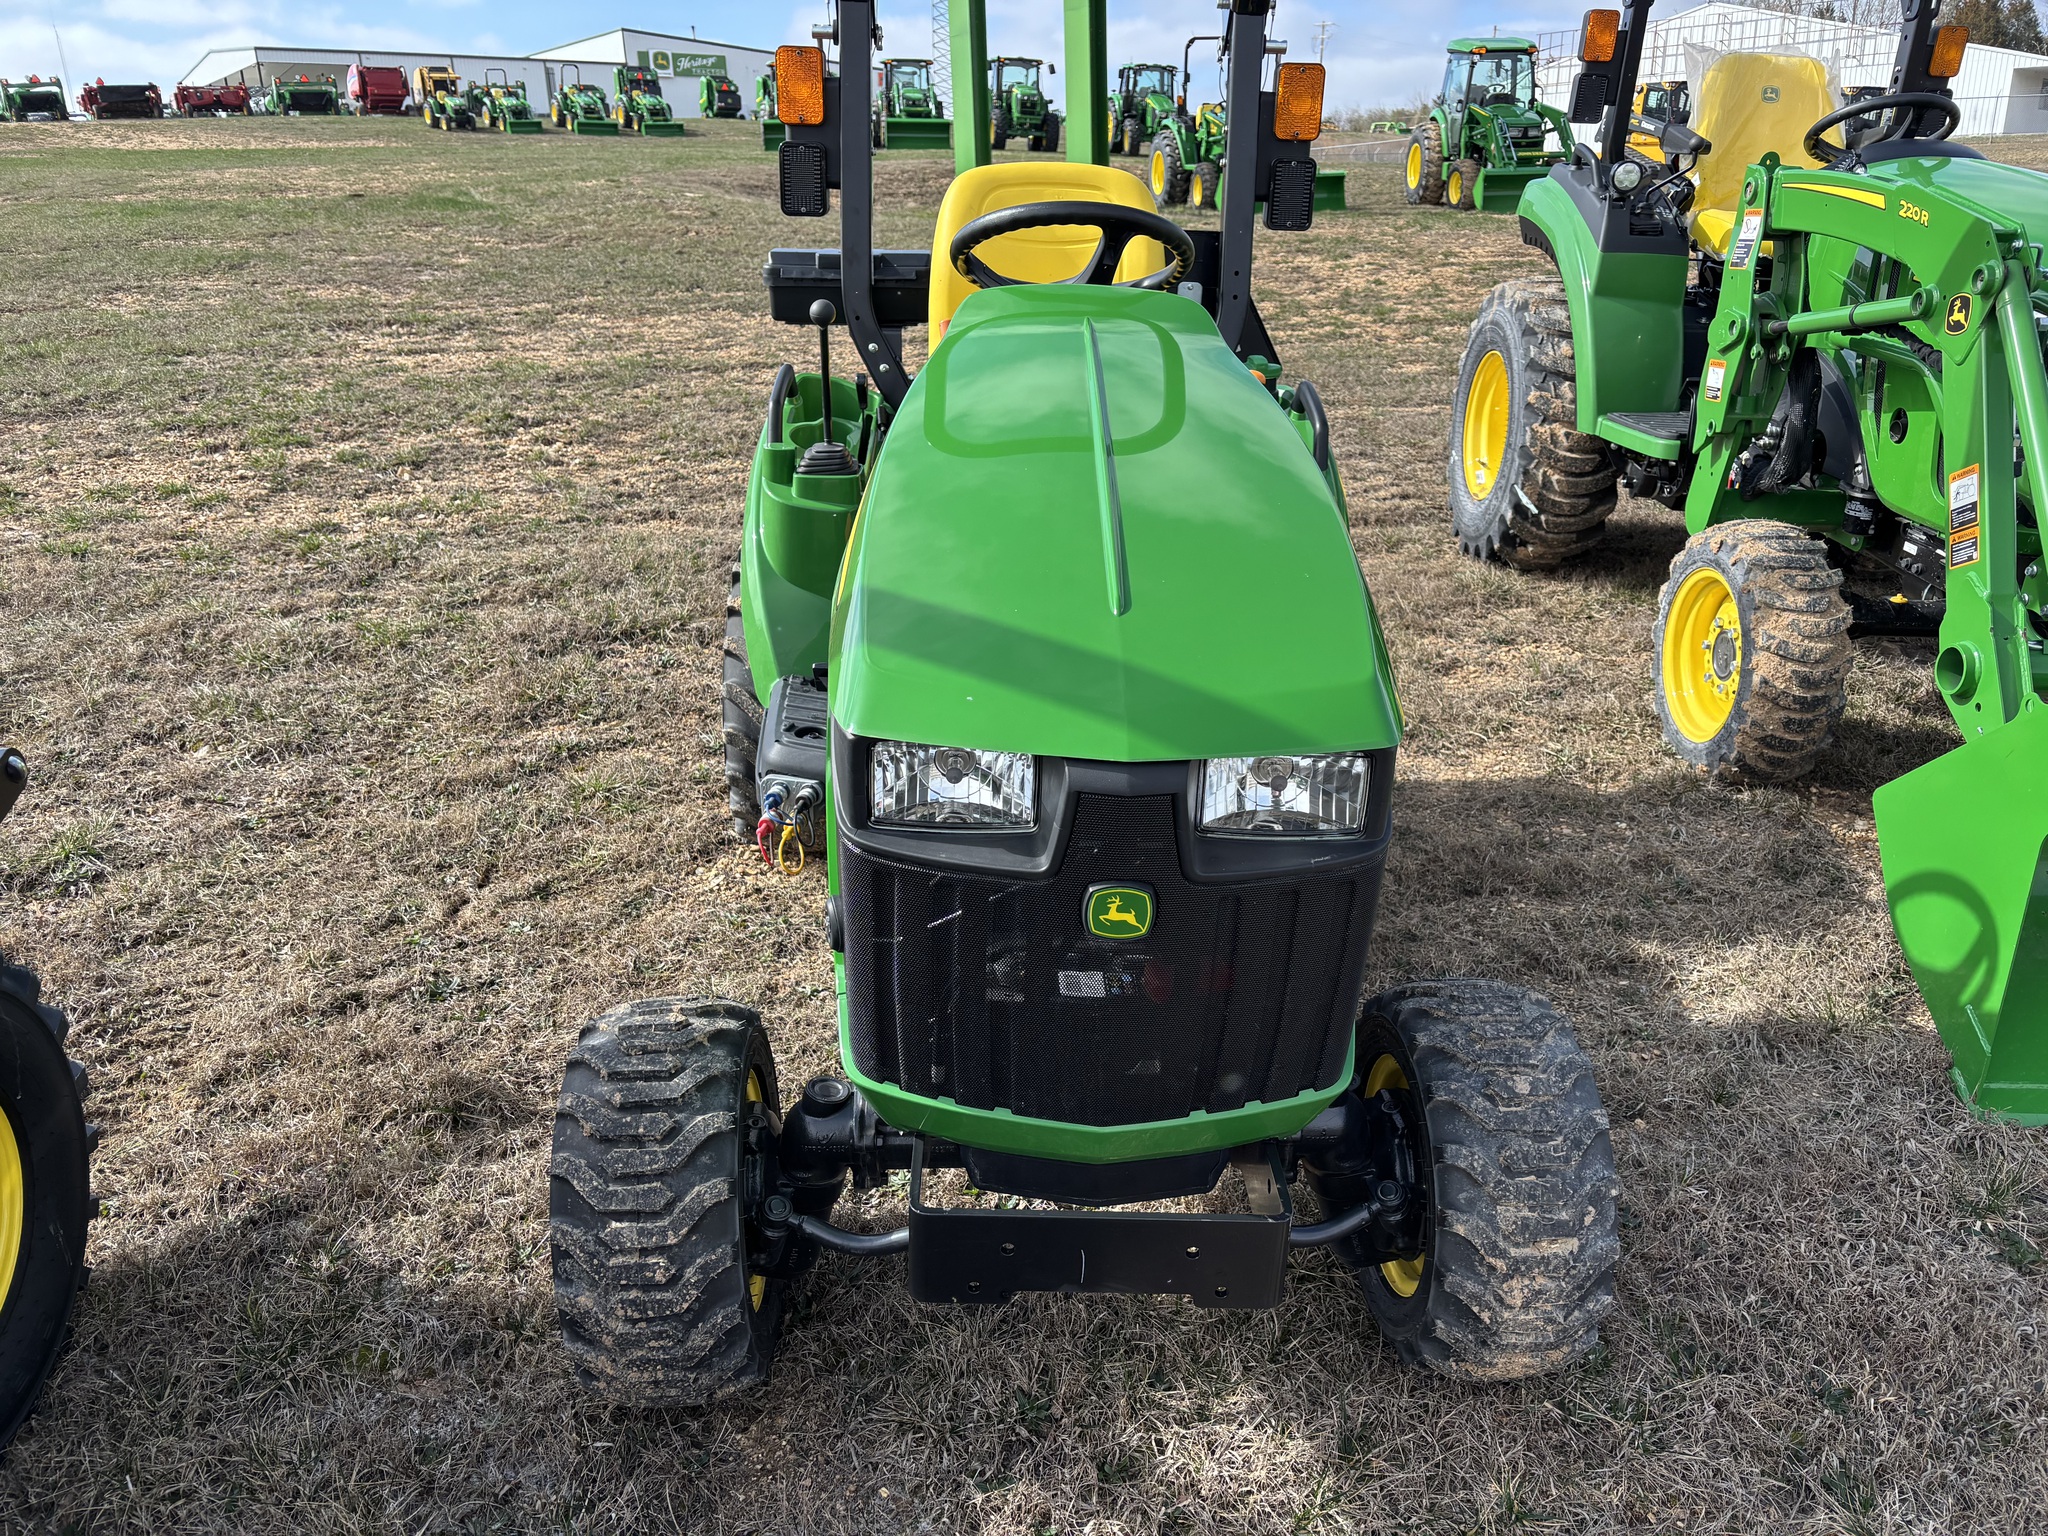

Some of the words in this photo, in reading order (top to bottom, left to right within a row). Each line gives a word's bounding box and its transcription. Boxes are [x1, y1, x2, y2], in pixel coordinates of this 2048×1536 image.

[676, 55, 717, 72] Heritage
[691, 67, 726, 76] TRACTOR
[1898, 199, 1929, 228] 220R
[1956, 466, 1976, 479] WARNING
[1957, 529, 1976, 541] WARNING
